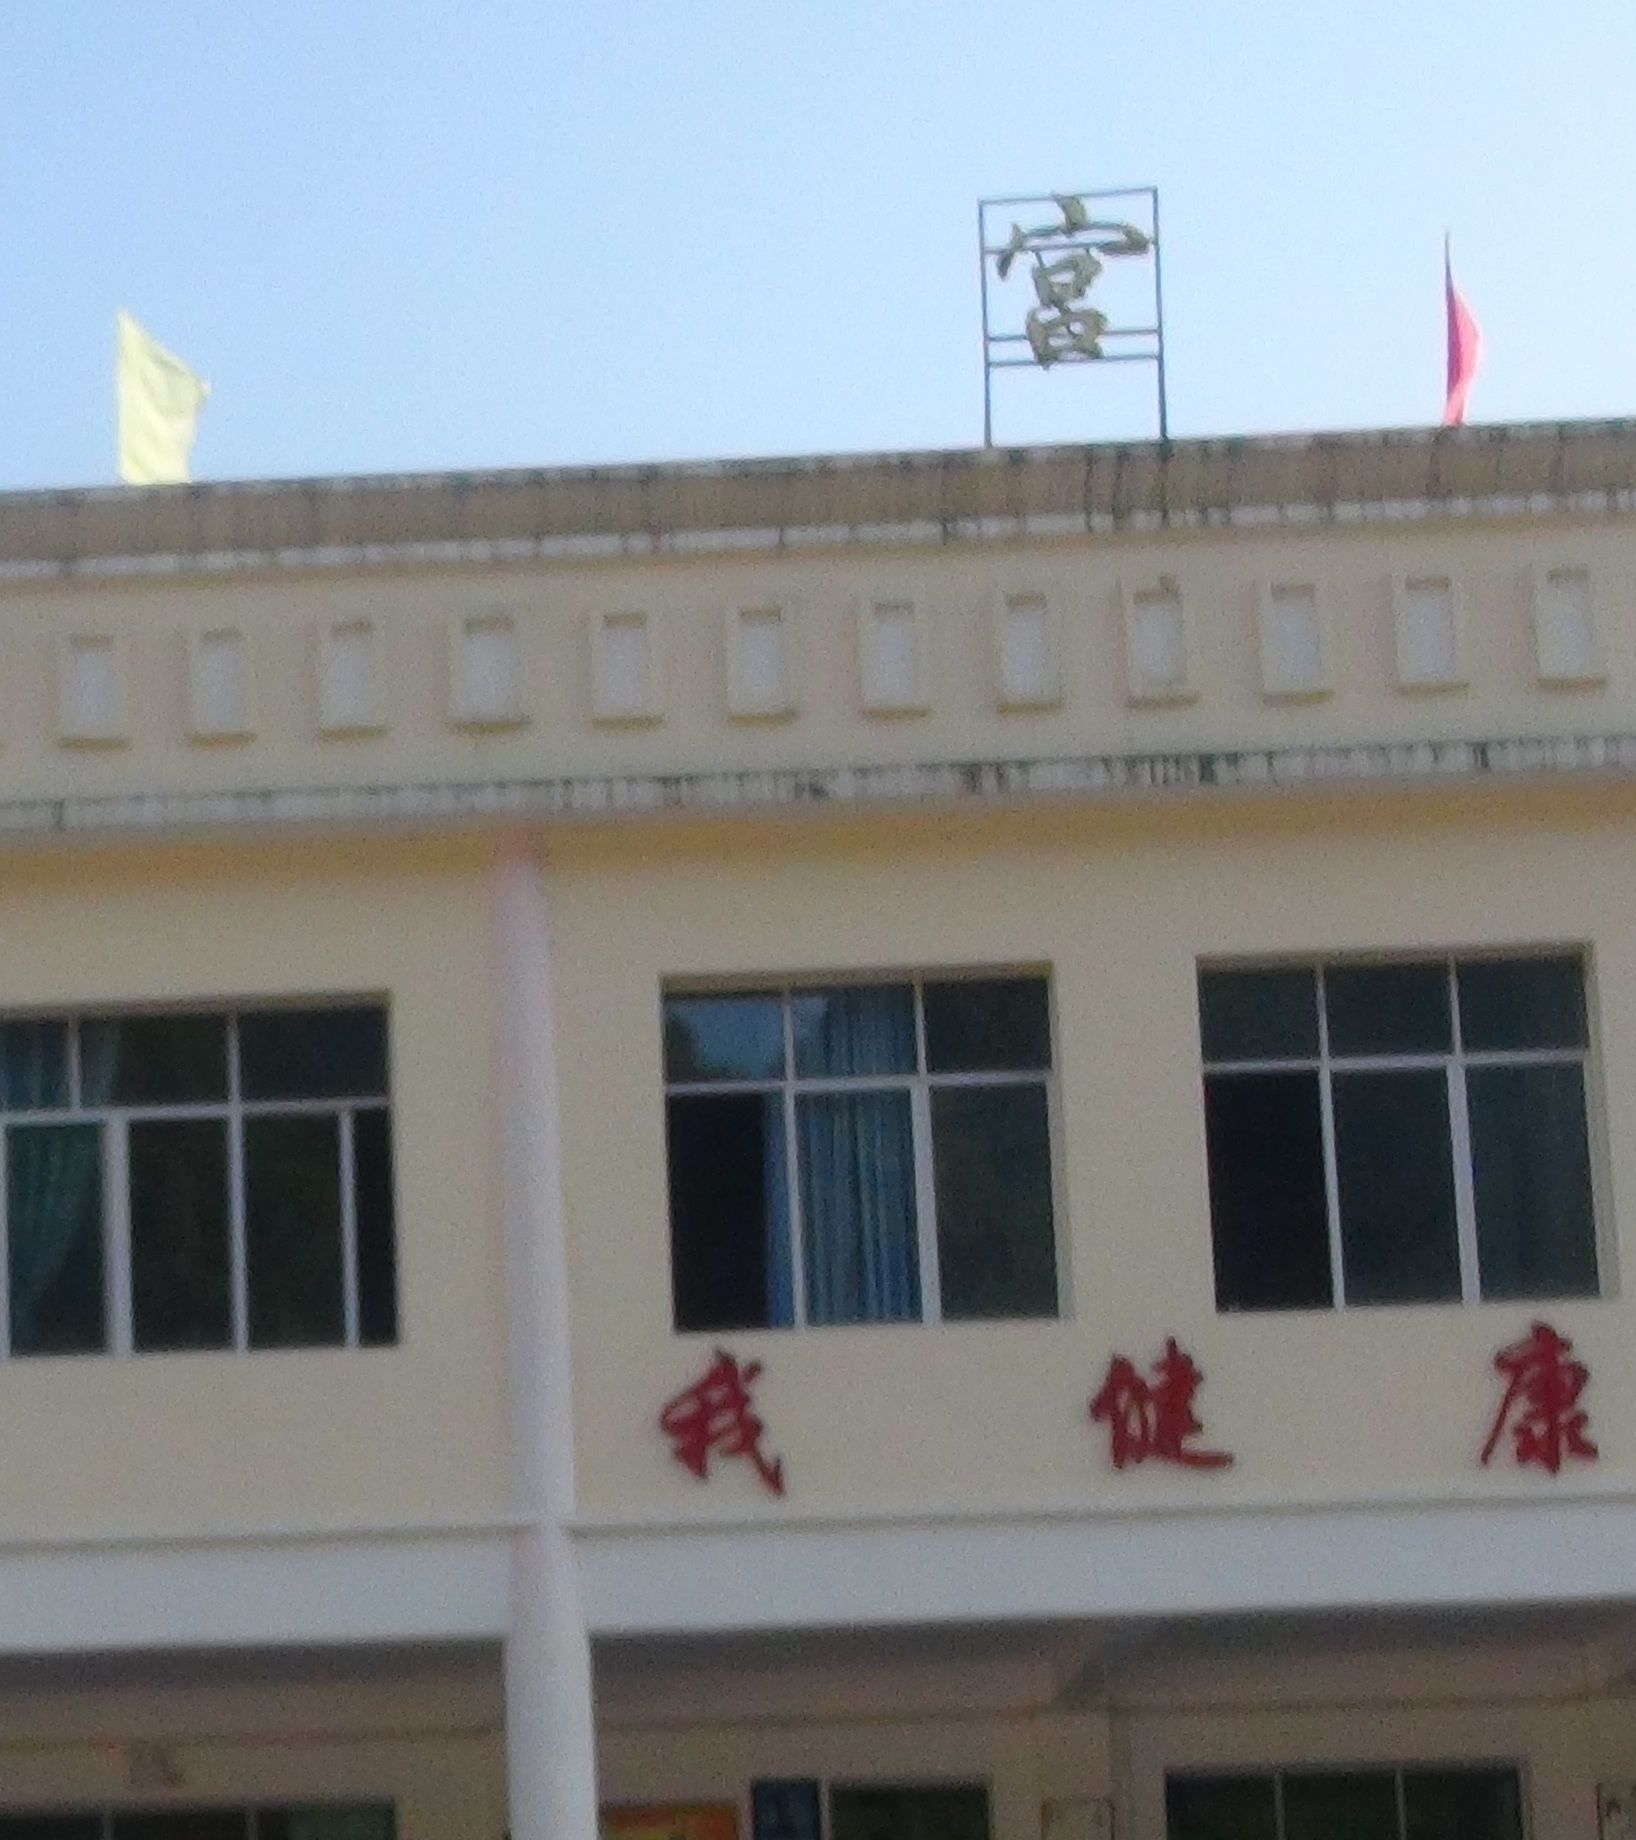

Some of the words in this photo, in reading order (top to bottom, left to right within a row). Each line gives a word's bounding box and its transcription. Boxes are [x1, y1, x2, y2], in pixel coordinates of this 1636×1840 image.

[996, 194, 1152, 371] 宫
[660, 1349, 787, 1497] 我
[1090, 1338, 1234, 1470] 健
[1479, 1320, 1599, 1476] 康
